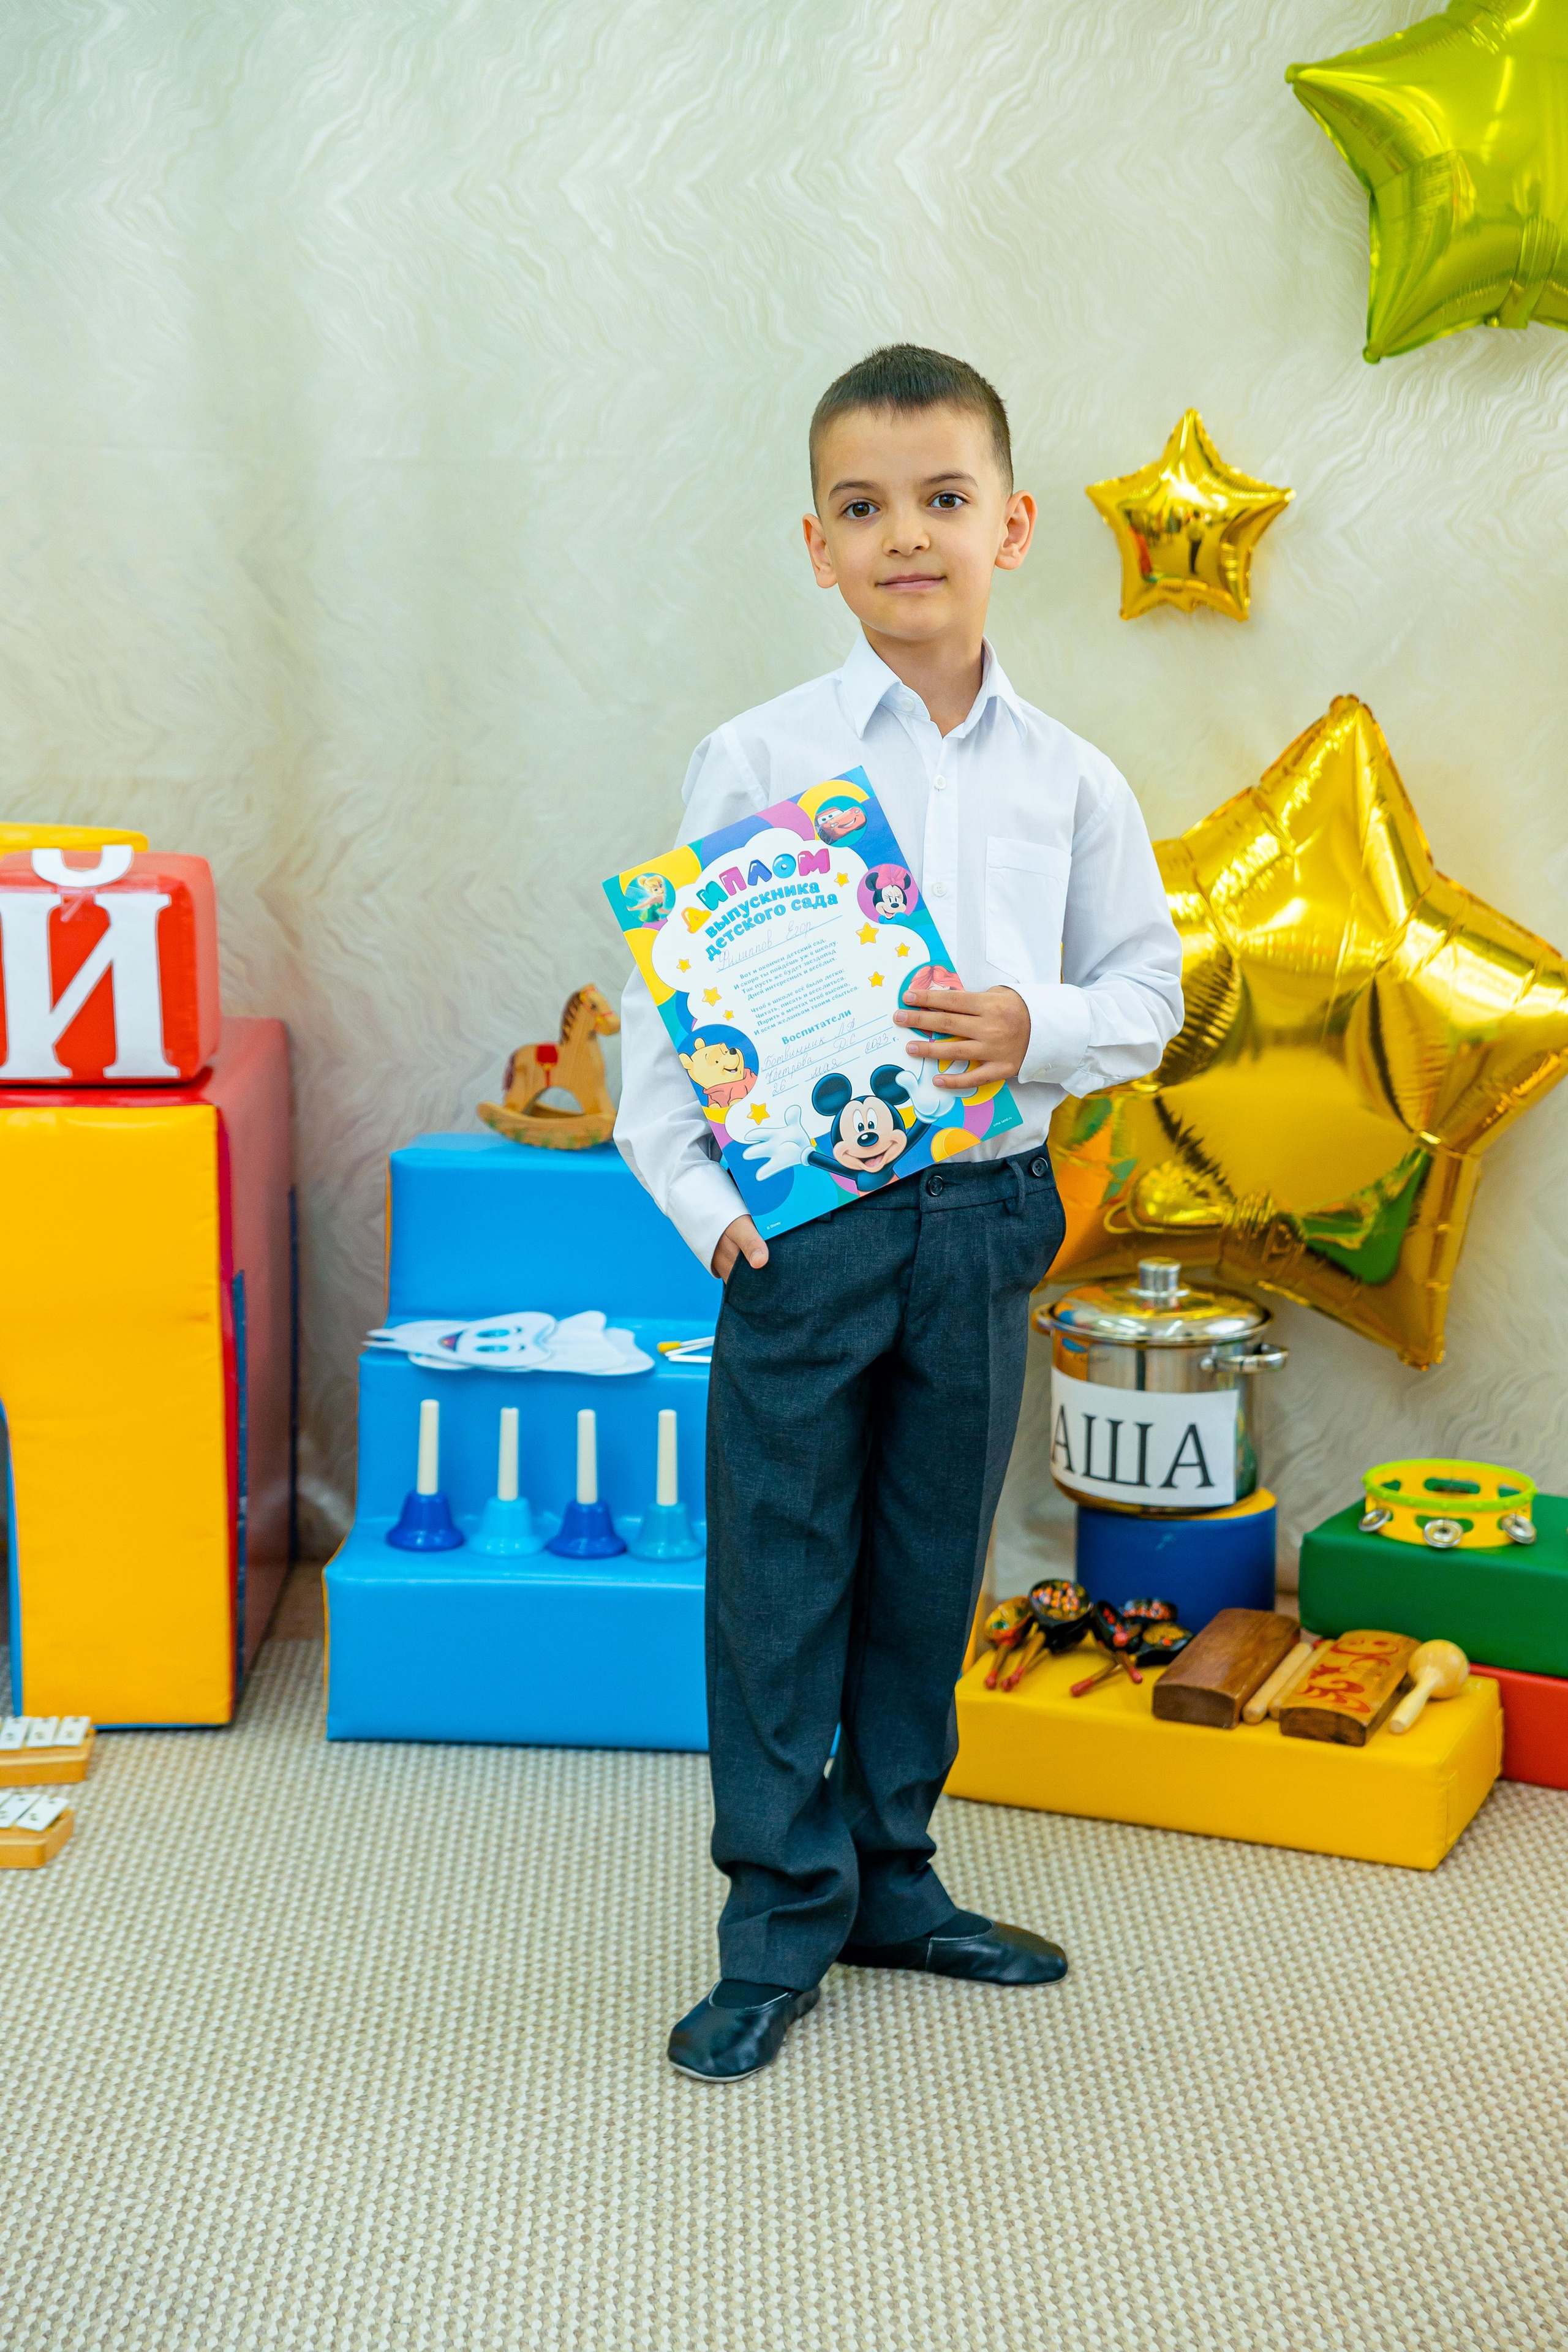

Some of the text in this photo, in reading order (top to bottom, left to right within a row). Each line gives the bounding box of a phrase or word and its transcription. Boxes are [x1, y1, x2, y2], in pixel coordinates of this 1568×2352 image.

[681, 848, 831, 933] ДИПЛОМ
[705, 882, 820, 938] выпускника
[706, 894, 838, 962] детского сада
[786, 920, 813, 940] Егор
[0, 845, 179, 1078] Й
[739, 971, 751, 979] Вот
[758, 956, 785, 971] окончен
[786, 943, 812, 959] детский
[740, 976, 759, 987] скоро
[769, 959, 798, 974] пойдёшь
[814, 940, 838, 953] школу.
[747, 987, 764, 1001] Дней
[764, 972, 802, 992] интересных
[808, 957, 837, 971] весёлых.
[754, 978, 772, 988] пусть
[783, 964, 802, 975] будет
[803, 949, 836, 966] звездопад
[750, 1003, 766, 1012] Чтоб
[772, 992, 793, 1004] школе
[805, 978, 823, 989] было
[824, 968, 844, 981] легко:
[755, 1007, 780, 1018] Читать,
[780, 996, 802, 1008] писать
[808, 976, 845, 995] веселиться.
[756, 1014, 780, 1026] Парить
[785, 1001, 808, 1013] мечтах
[809, 992, 824, 1002] чтоб
[824, 982, 850, 995] высоко,
[760, 1023, 776, 1033] всем
[777, 1008, 810, 1025] желаньям
[810, 998, 831, 1009] твоим
[831, 986, 859, 1000] сбыться.
[781, 1009, 851, 1045] Воспитатели
[772, 1079, 786, 1096] 26
[811, 1058, 841, 1079] мая
[865, 1033, 889, 1054] 2023
